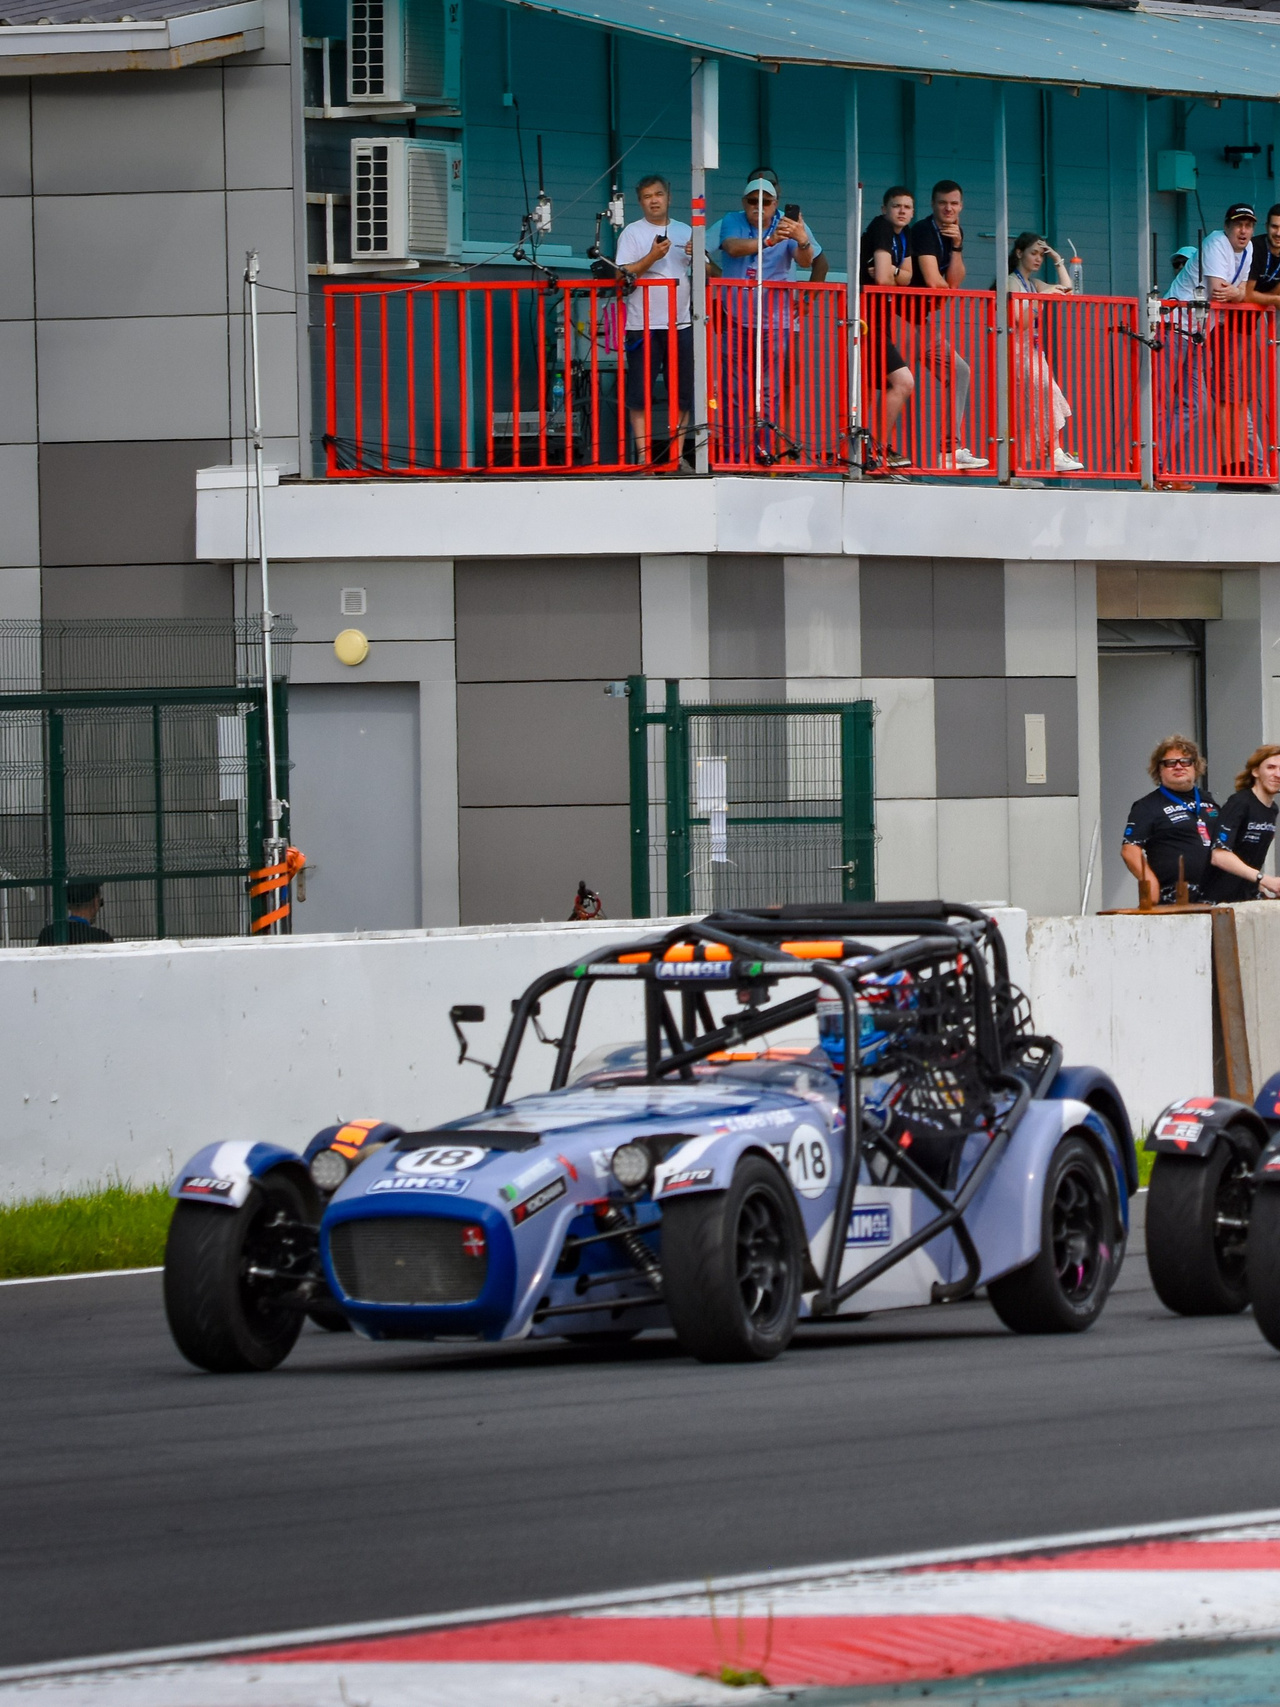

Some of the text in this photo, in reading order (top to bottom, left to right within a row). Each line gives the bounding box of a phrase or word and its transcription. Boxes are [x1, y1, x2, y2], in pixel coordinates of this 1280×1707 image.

[660, 961, 729, 979] AIMOL
[415, 1149, 470, 1168] 18
[795, 1141, 827, 1180] 18
[373, 1177, 463, 1191] AIMOL
